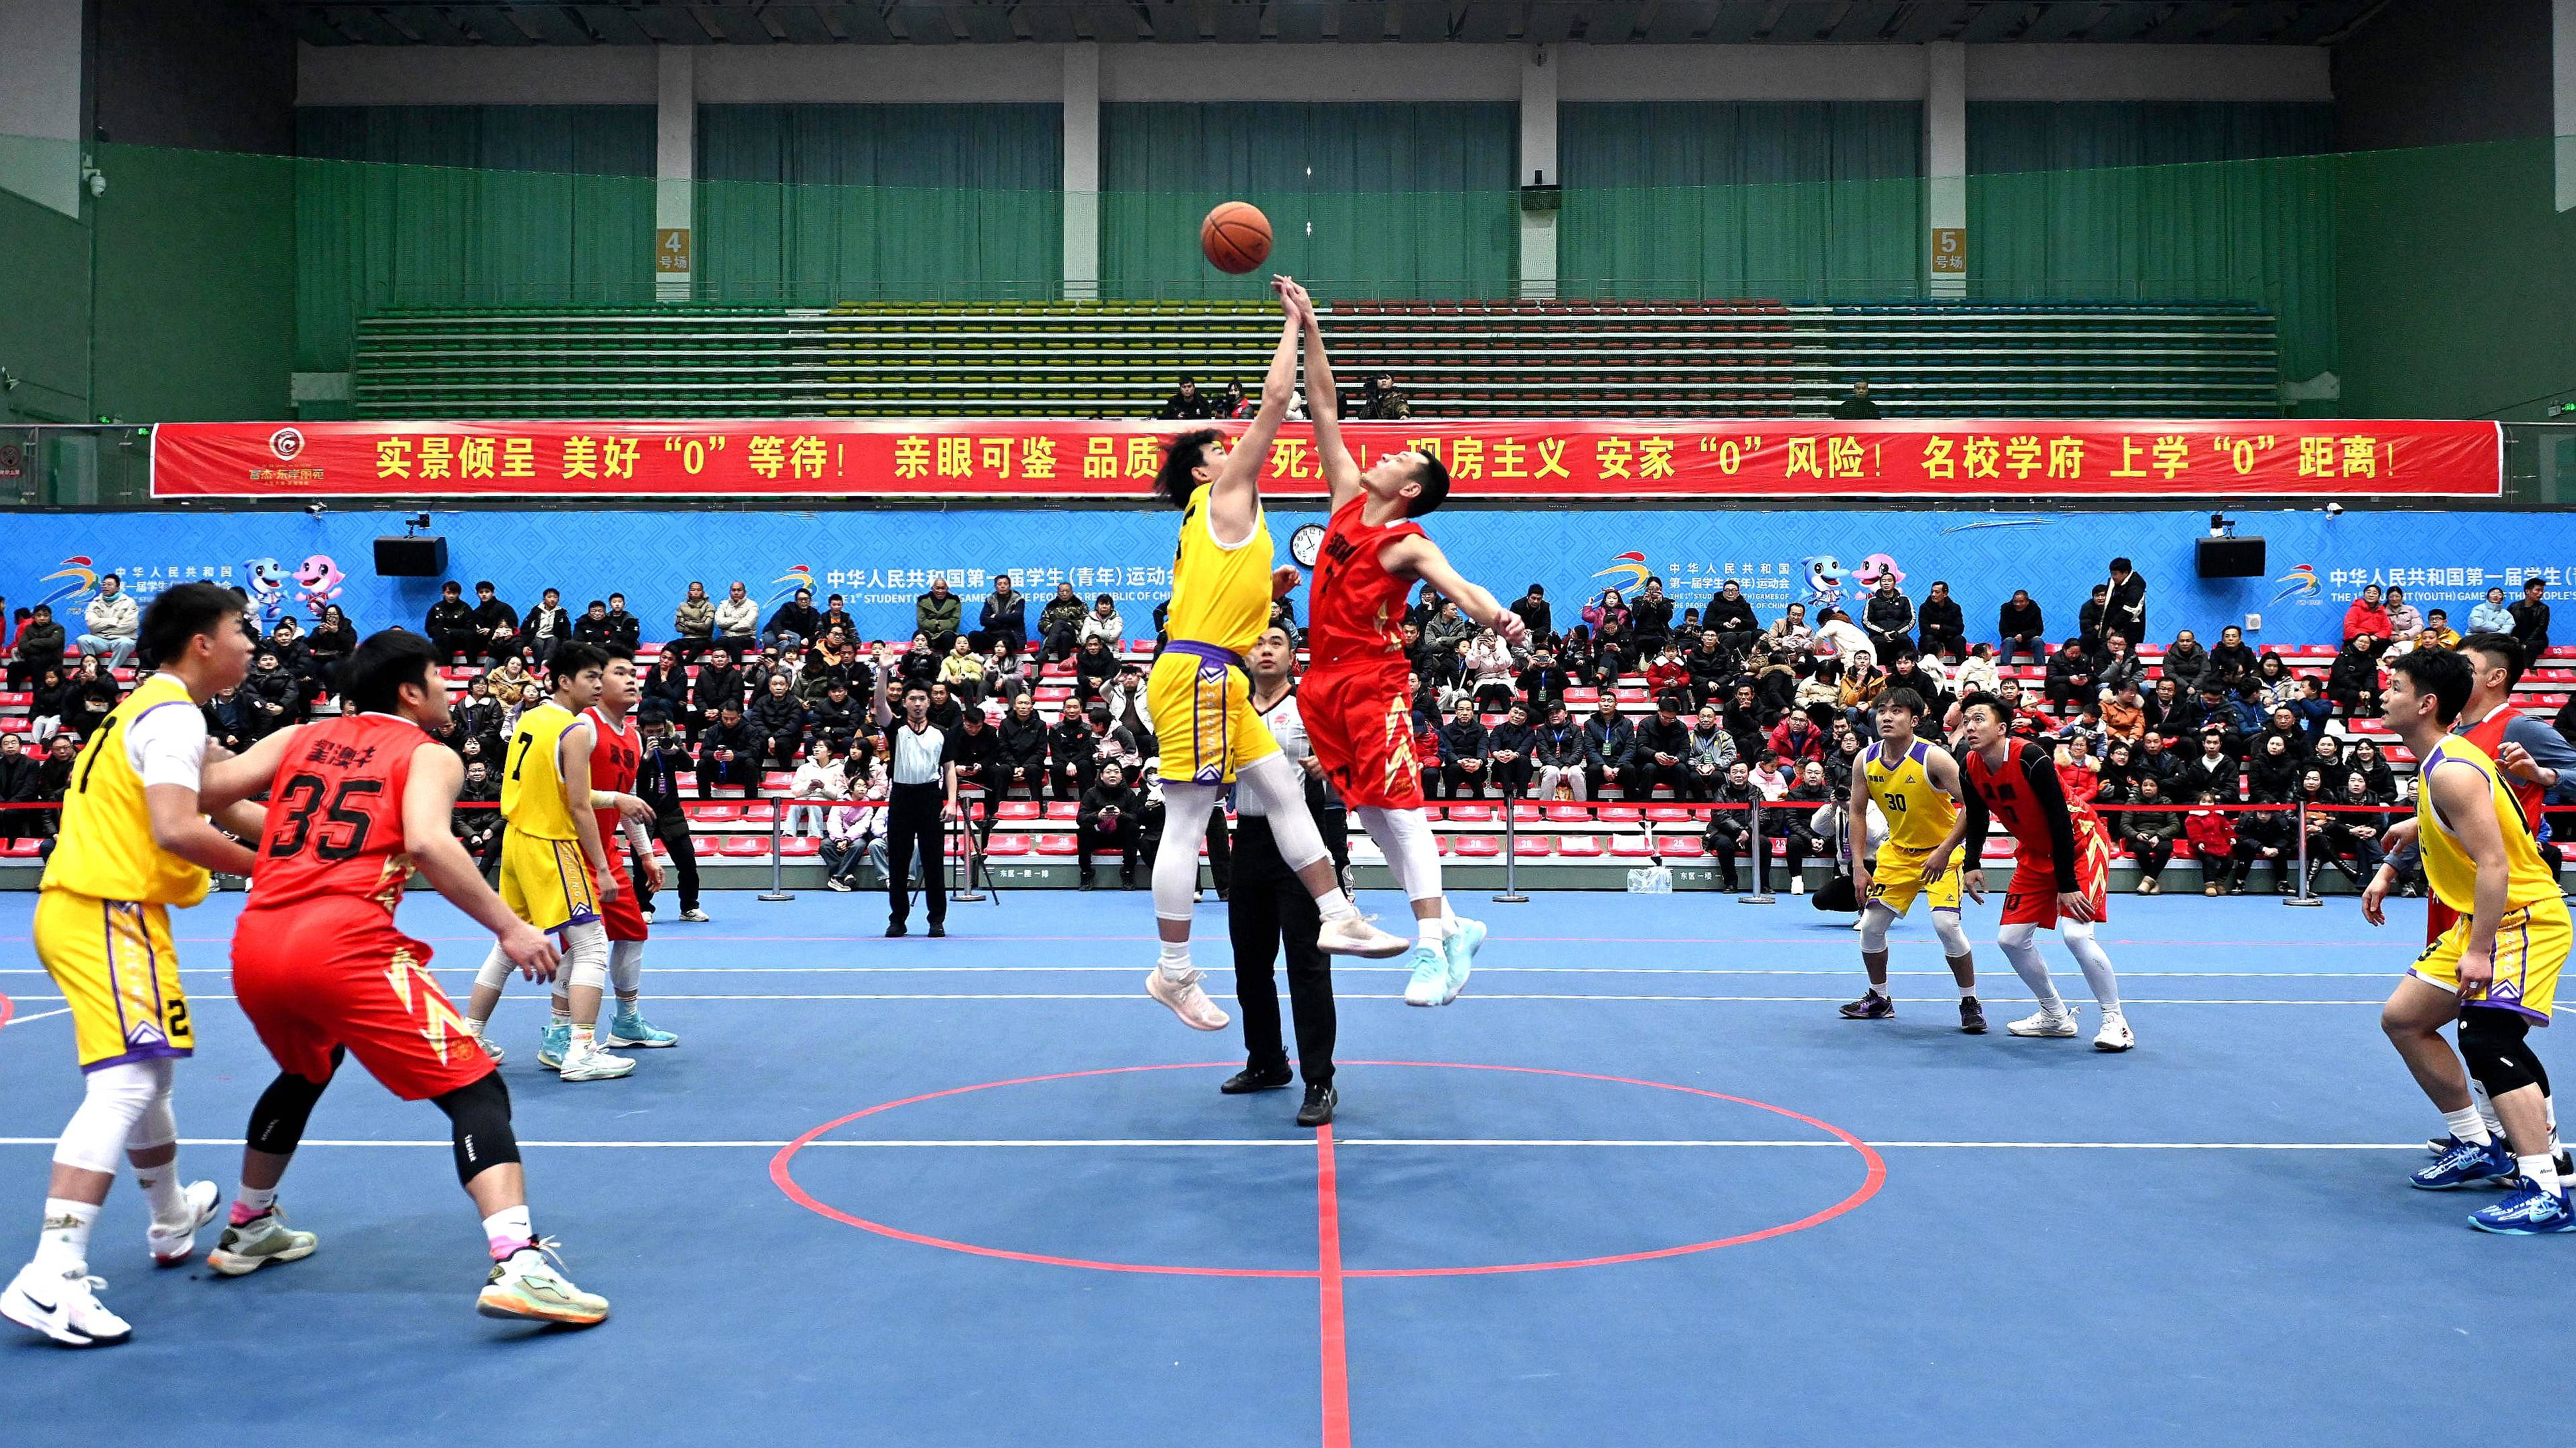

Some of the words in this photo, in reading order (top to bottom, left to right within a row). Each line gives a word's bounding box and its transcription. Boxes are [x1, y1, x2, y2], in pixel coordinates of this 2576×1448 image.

[665, 232, 682, 252] 4
[1942, 232, 1957, 252] 5
[660, 256, 686, 268] 号场
[1936, 255, 1963, 268] 号场
[376, 436, 536, 479] 实景倾呈
[563, 436, 640, 479] 美好
[895, 436, 1057, 479] 亲眼可鉴
[1083, 436, 1158, 479] 品质
[1596, 436, 1675, 479] 安家
[1921, 436, 2085, 479] 名校学府
[2110, 436, 2190, 479] 上学
[115, 566, 232, 578] 中华人民共和国
[1669, 562, 1790, 574] 中华人民共和国
[864, 594, 911, 604] STUDENT
[1137, 592, 1150, 601] OF
[2332, 592, 2350, 602] THE
[2415, 591, 2456, 602] (YOUTH)
[512, 732, 533, 781] 7
[2395, 747, 2405, 756] 10
[1884, 793, 1907, 812] 30
[269, 773, 384, 861] 35
[745, 838, 755, 847] 41
[1775, 839, 1785, 848] 23
[169, 999, 188, 1036] 2
